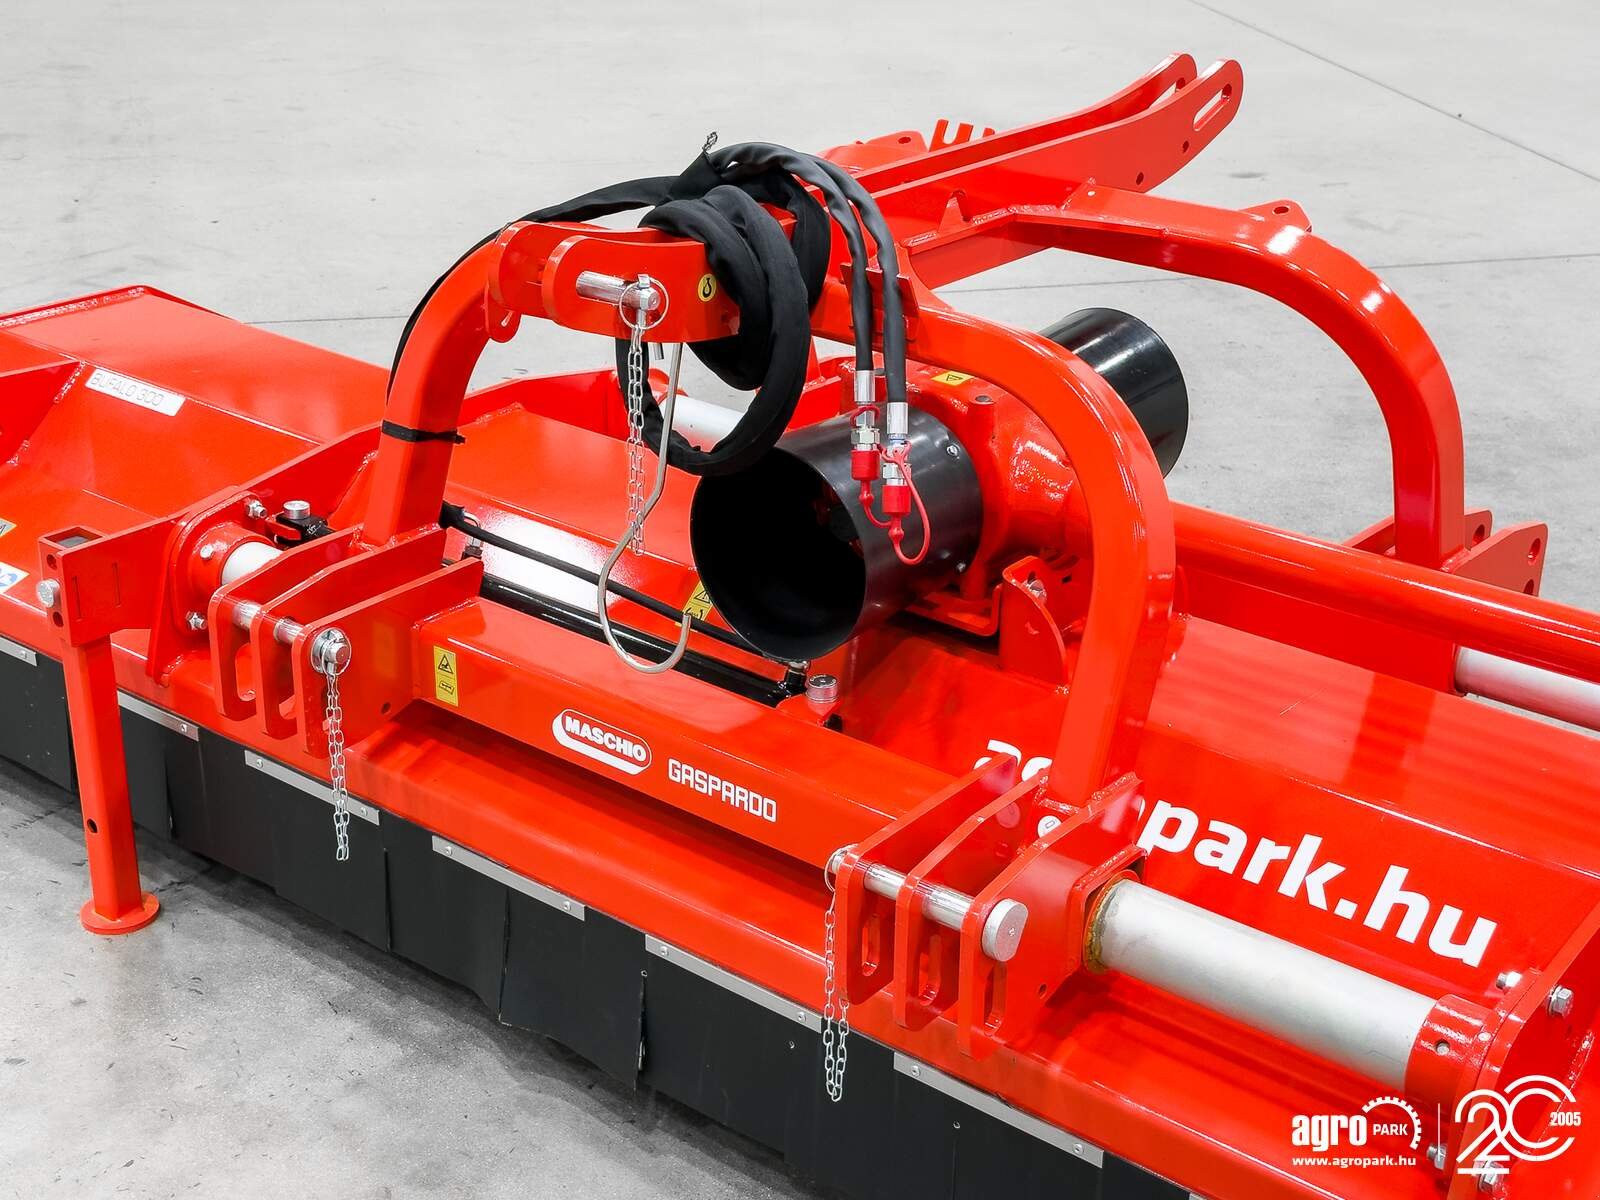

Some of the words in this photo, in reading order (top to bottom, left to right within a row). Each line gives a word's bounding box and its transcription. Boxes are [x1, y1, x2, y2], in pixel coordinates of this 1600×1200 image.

[91, 373, 137, 397] BUFALO
[136, 389, 164, 406] 300
[565, 716, 647, 762] MASCHIO
[668, 758, 777, 823] GASPARDO
